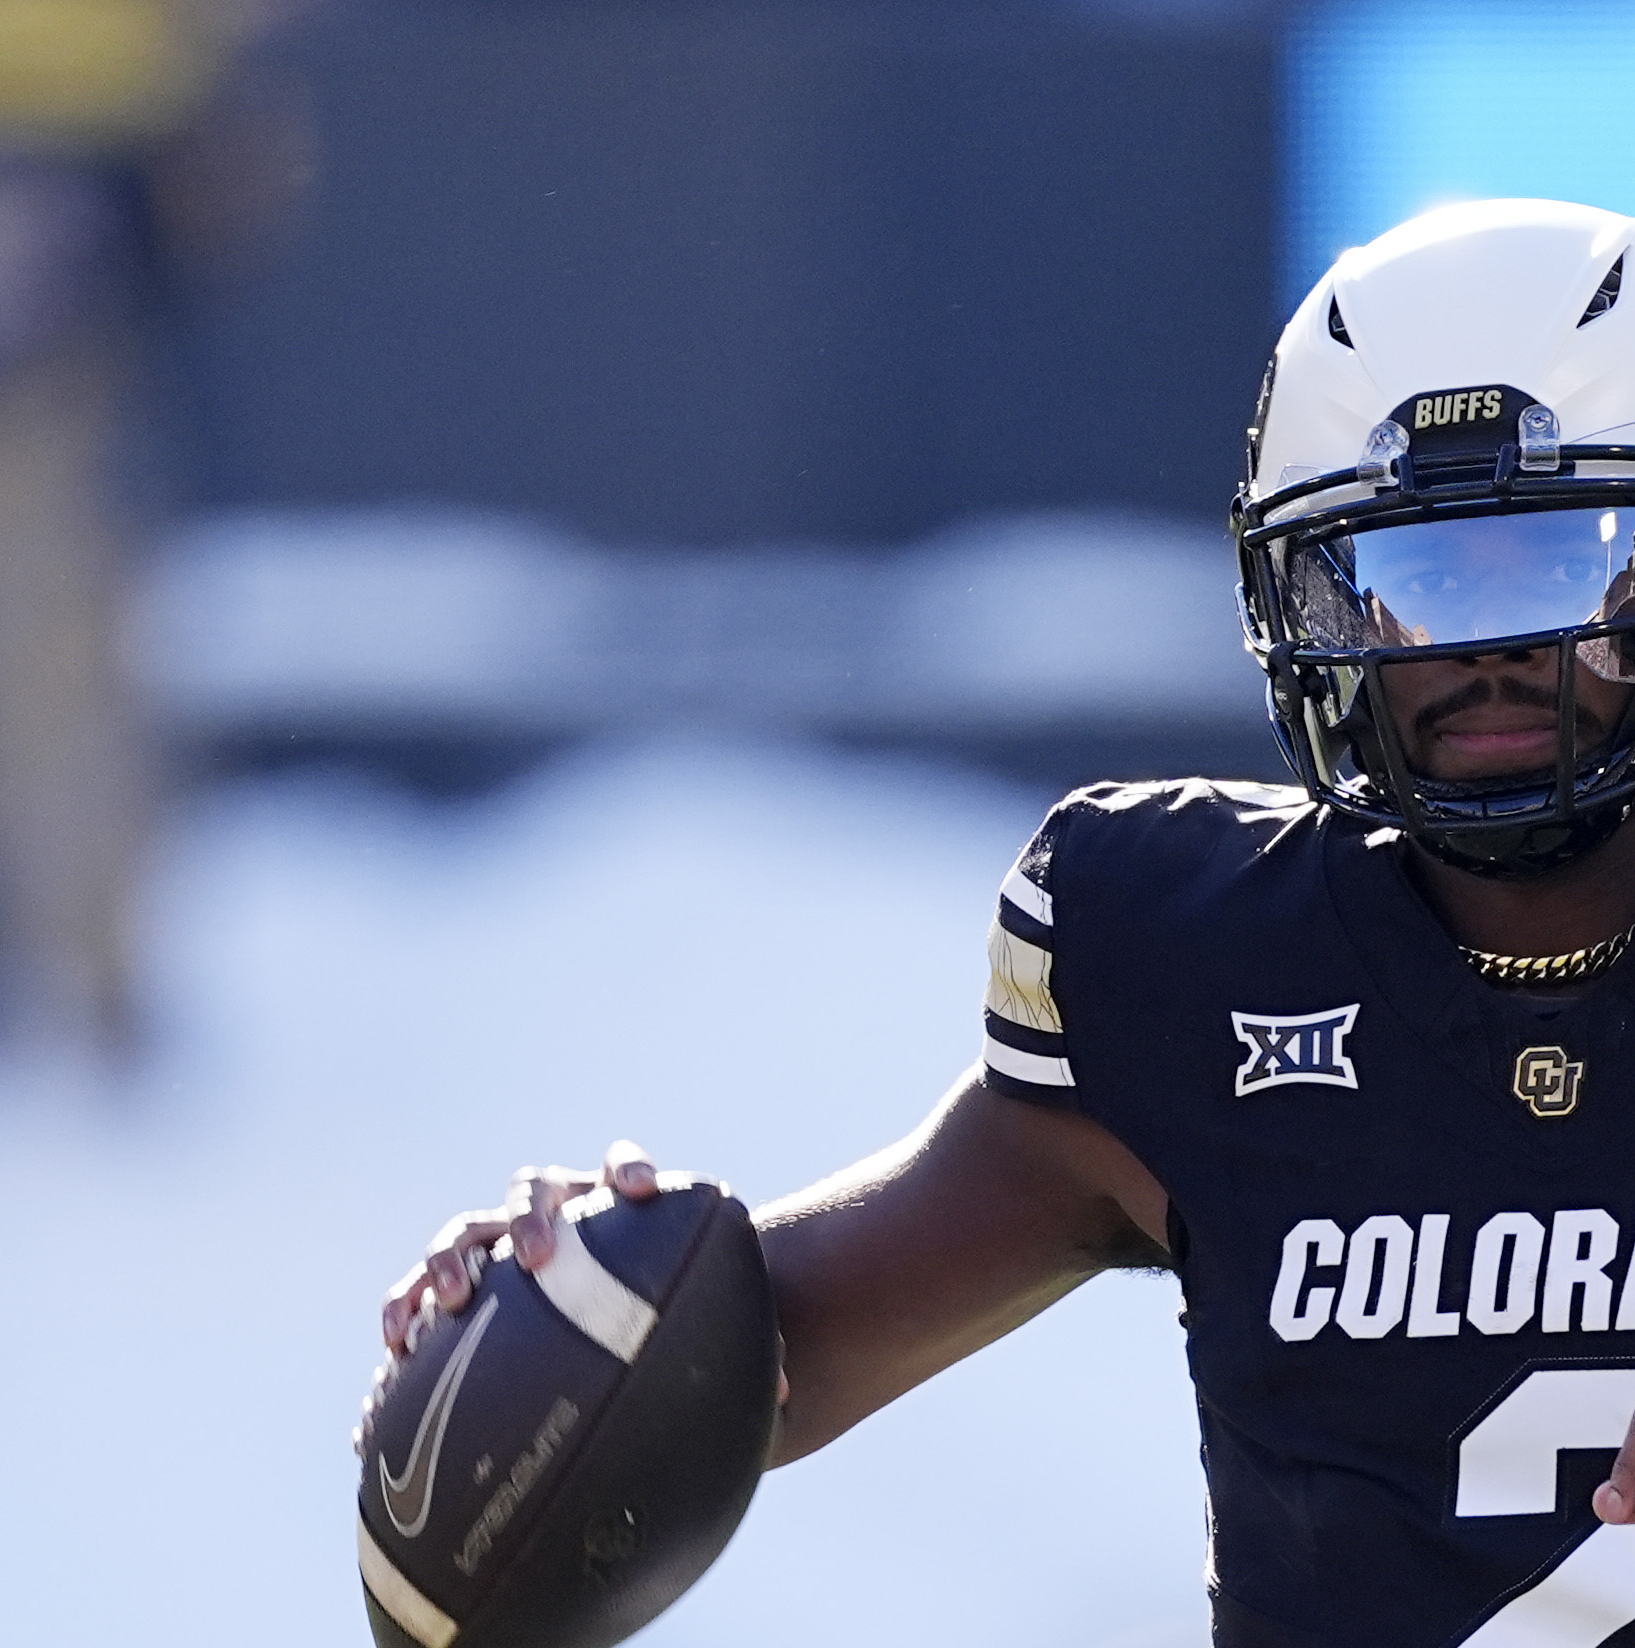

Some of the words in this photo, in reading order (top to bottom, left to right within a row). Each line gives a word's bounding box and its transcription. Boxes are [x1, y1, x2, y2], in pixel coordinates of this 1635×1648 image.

[1414, 389, 1503, 430] BUFFS
[1237, 1009, 1353, 1092] XII
[1513, 1046, 1583, 1117] CU
